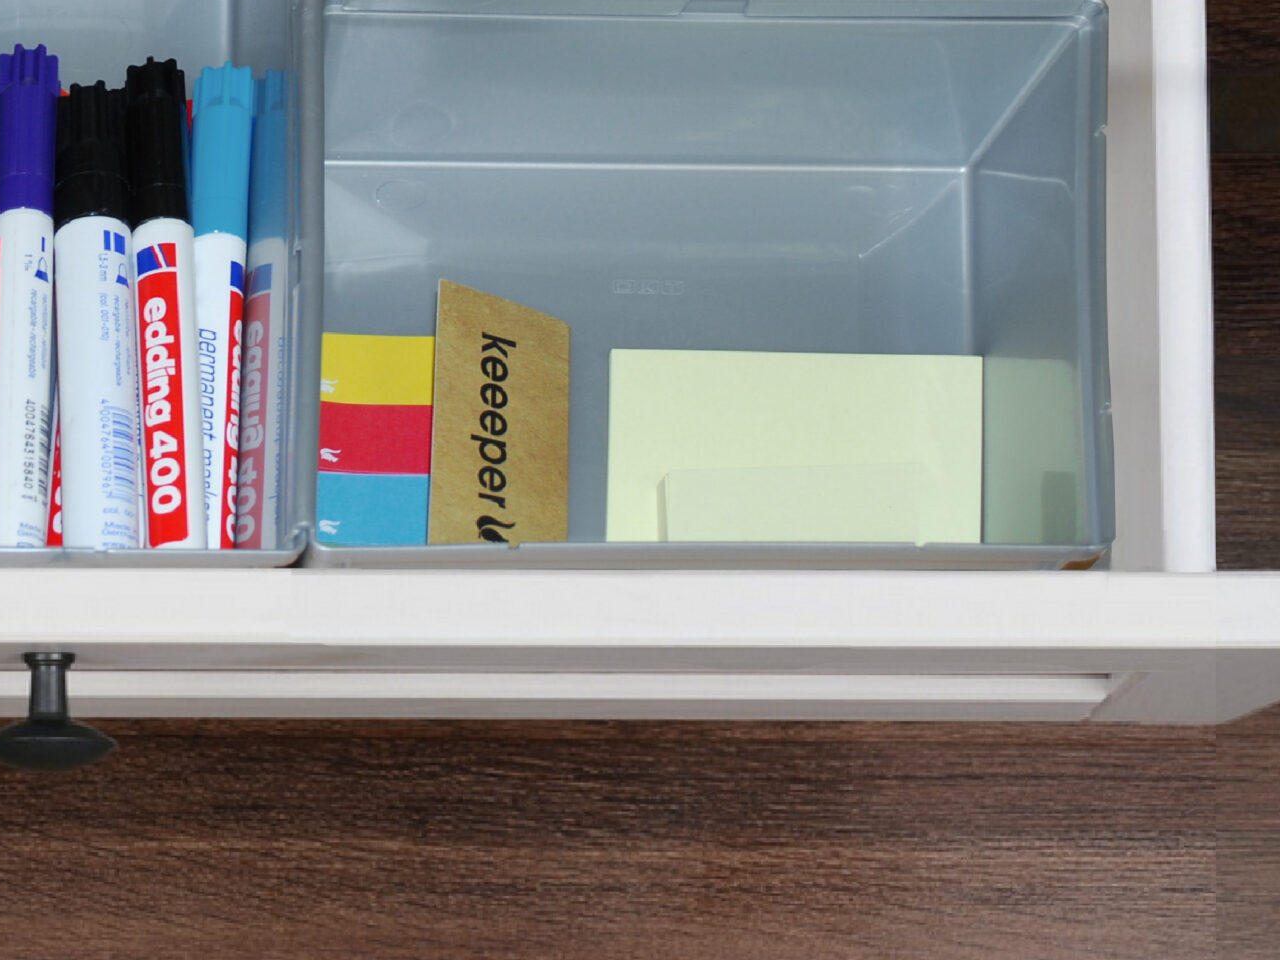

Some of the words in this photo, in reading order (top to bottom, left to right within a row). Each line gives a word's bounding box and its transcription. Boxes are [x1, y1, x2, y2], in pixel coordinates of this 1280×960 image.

[143, 297, 176, 428] edding
[470, 331, 517, 509] keeeper
[148, 431, 182, 515] 400
